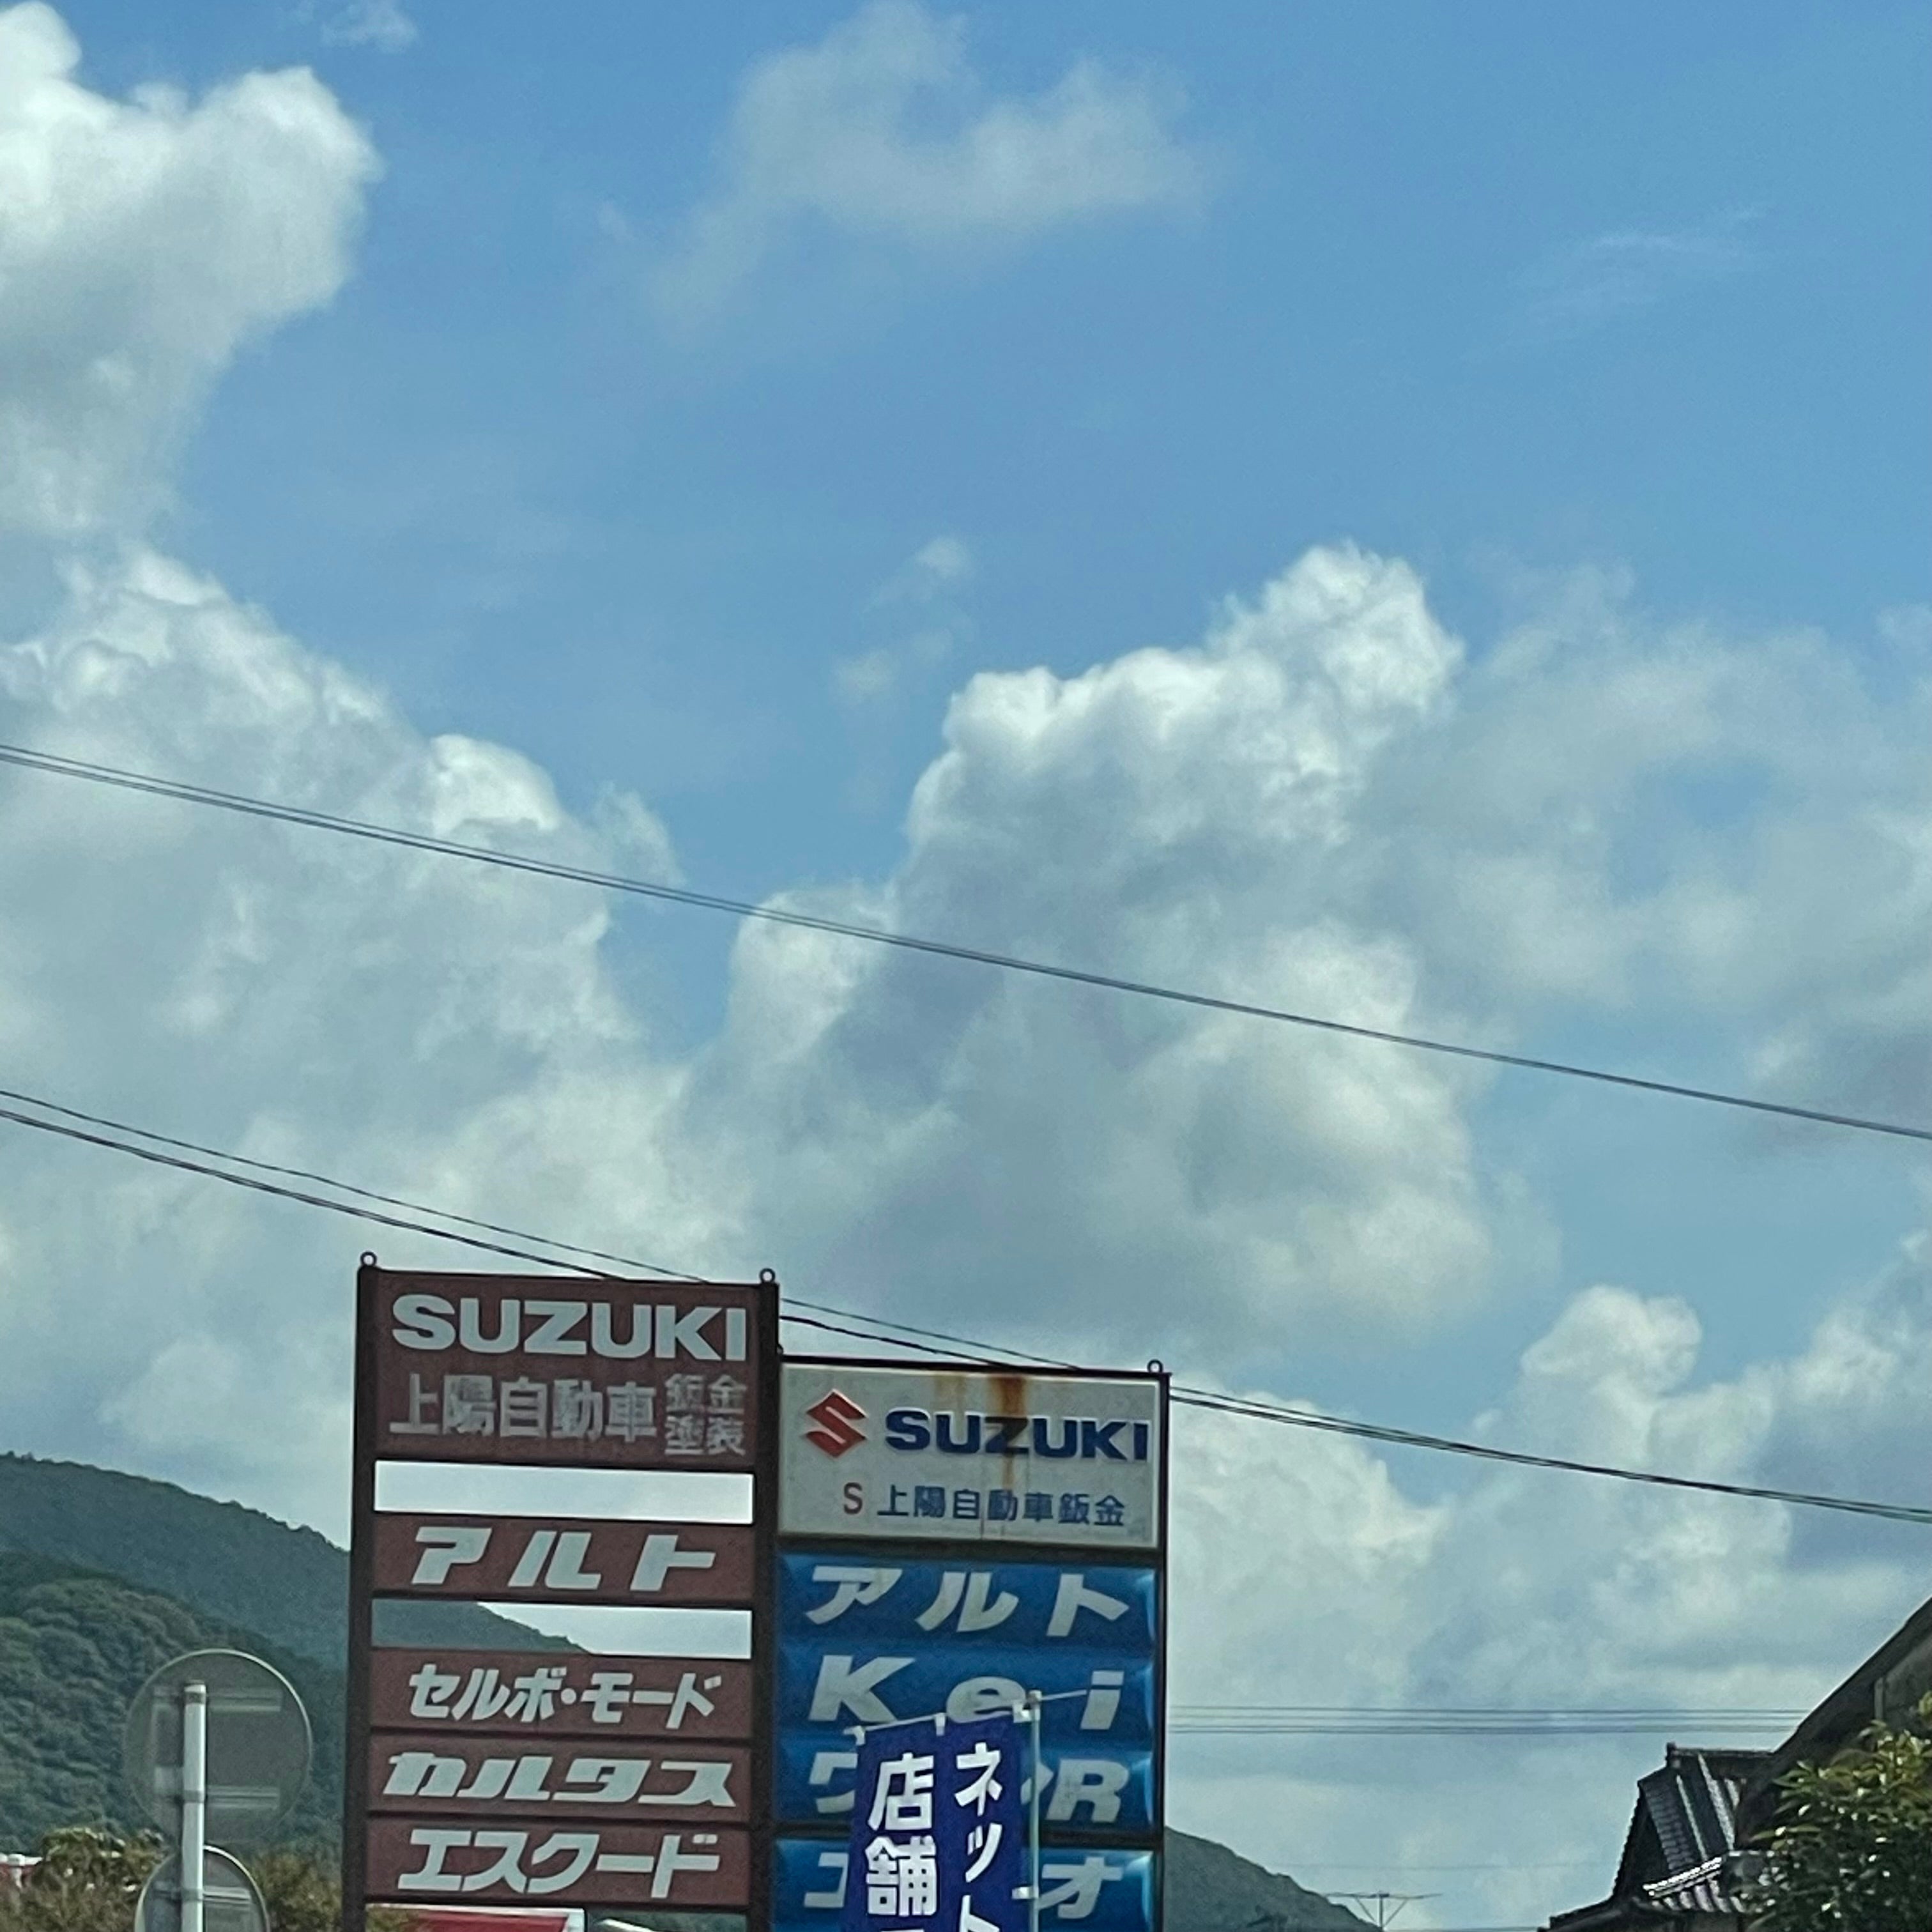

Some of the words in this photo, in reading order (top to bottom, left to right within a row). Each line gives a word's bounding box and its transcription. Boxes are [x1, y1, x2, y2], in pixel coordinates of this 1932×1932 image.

[392, 1294, 746, 1361] SUZUKI
[389, 1373, 657, 1443] 上陽自動車
[885, 1409, 1149, 1461] SUZUKI
[877, 1485, 1124, 1527] 上陽自動車鈑金
[411, 1526, 716, 1591] アルト
[805, 1565, 1130, 1637] アルト
[408, 1664, 722, 1729] セルボ・モード
[808, 1655, 1124, 1730] Kei
[383, 1752, 736, 1807] カルタス
[397, 1828, 721, 1899] エスクード
[865, 1752, 937, 1932] 店舗
